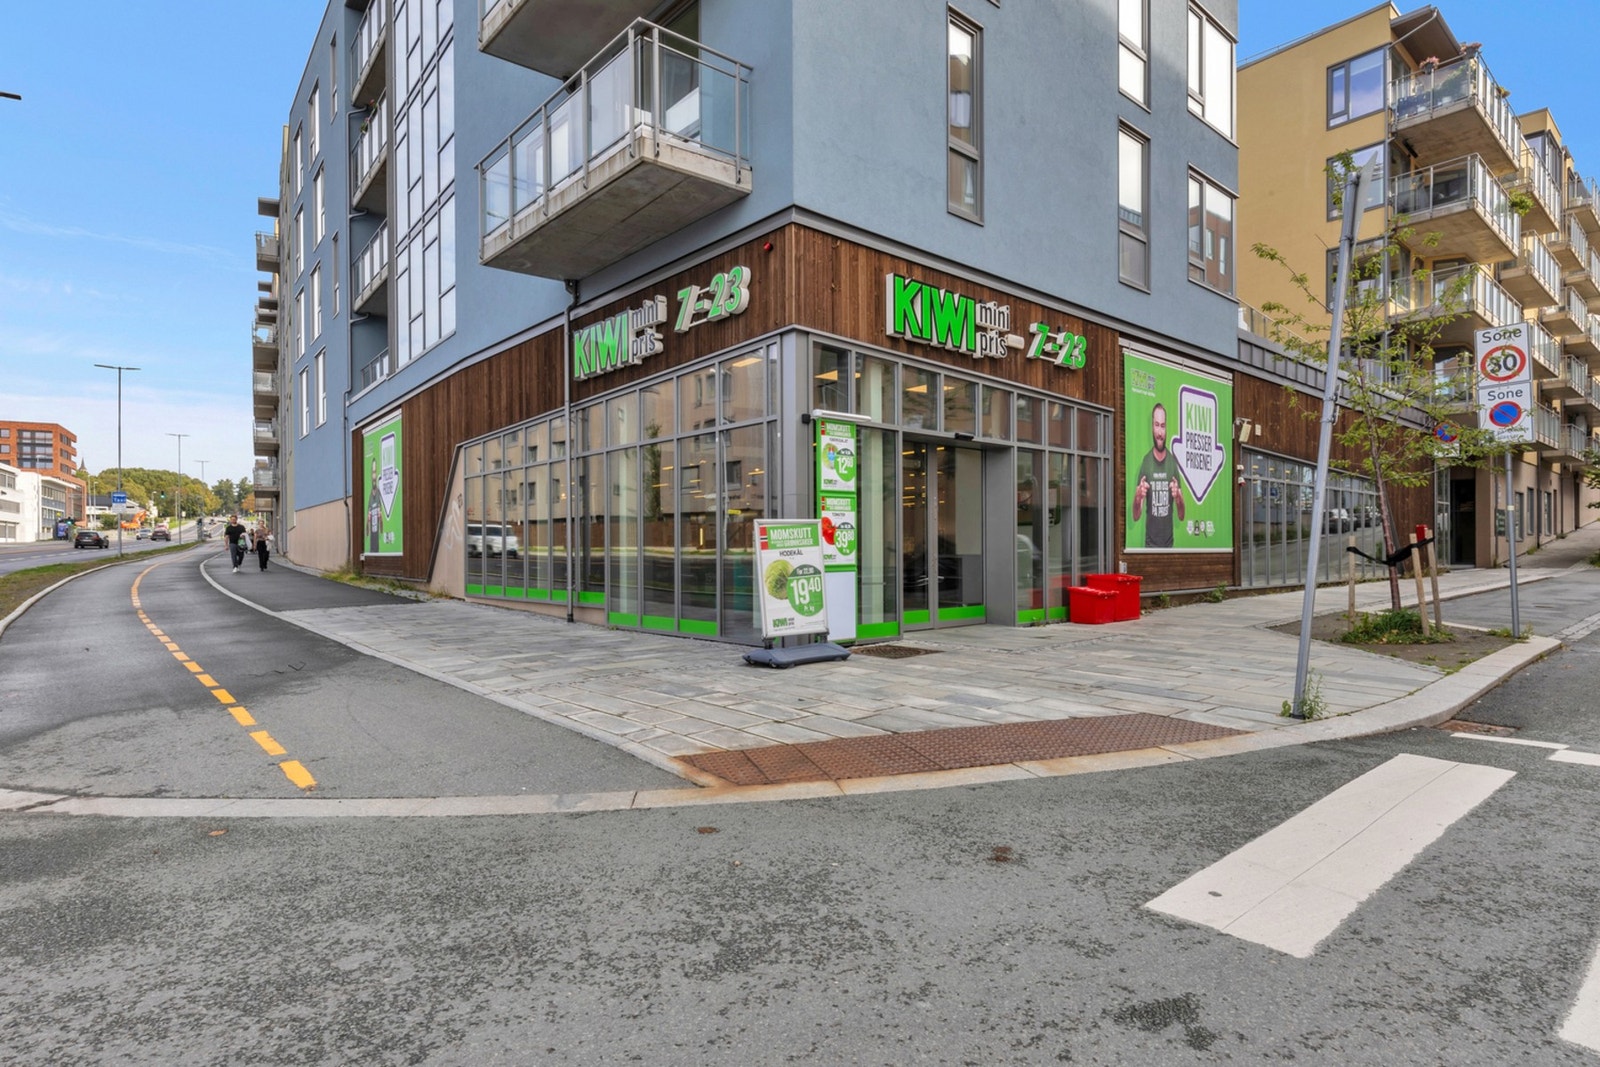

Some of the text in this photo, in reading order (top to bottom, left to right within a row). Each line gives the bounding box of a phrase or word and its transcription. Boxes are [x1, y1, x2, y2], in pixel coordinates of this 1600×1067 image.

[675, 266, 748, 332] 7-23
[889, 273, 976, 353] KIWI
[631, 298, 662, 330] mini
[978, 302, 1010, 331] mini
[573, 312, 629, 380] KIWI
[631, 330, 659, 363] pris
[979, 331, 1008, 358] pris
[1030, 323, 1088, 369] 7-23
[1482, 328, 1522, 343] Sone
[1488, 389, 1523, 401] Sone
[1186, 402, 1212, 433] KIWI
[1186, 432, 1212, 452] PRESSER
[1186, 451, 1212, 471] PRISENE!
[770, 527, 812, 540] MOMSKUTT
[779, 549, 804, 557] HODEKÅL
